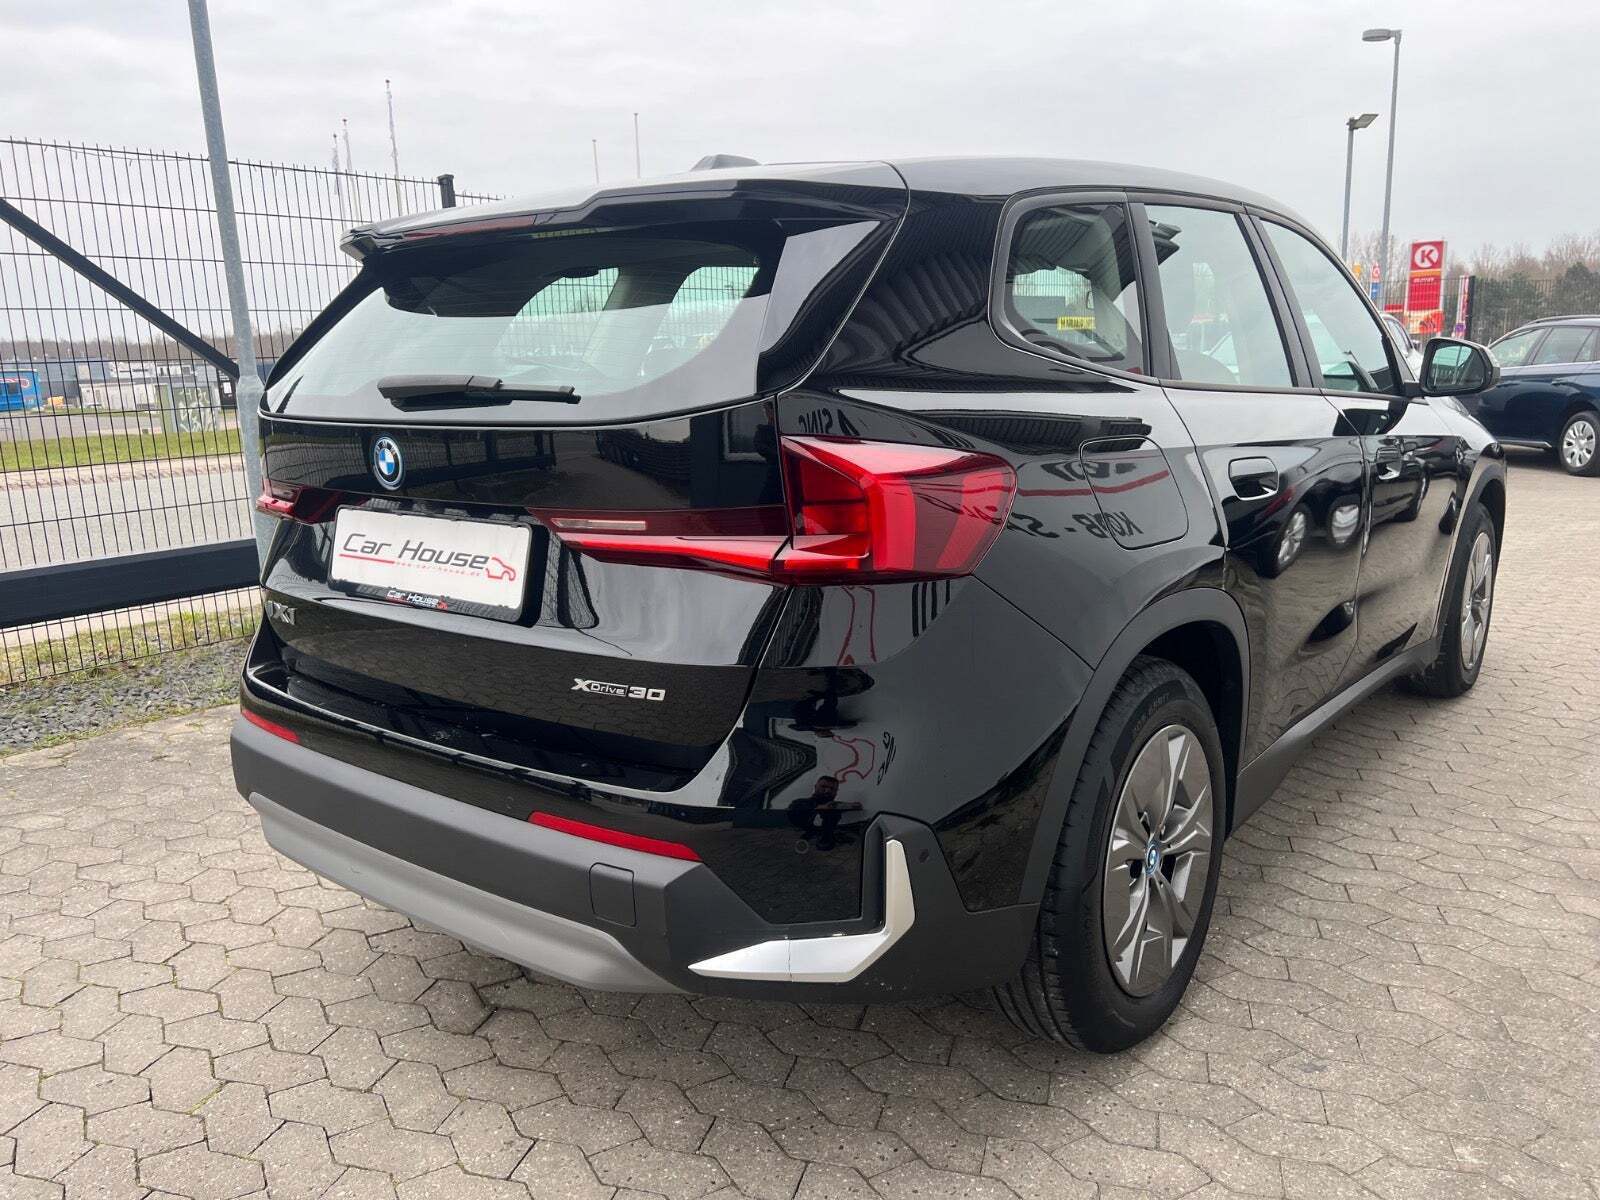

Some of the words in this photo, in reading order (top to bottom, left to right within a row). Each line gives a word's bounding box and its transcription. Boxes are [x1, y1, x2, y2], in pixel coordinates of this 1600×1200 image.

[343, 533, 392, 555] Car
[398, 540, 489, 570] House
[387, 590, 406, 600] Car
[406, 593, 438, 606] House
